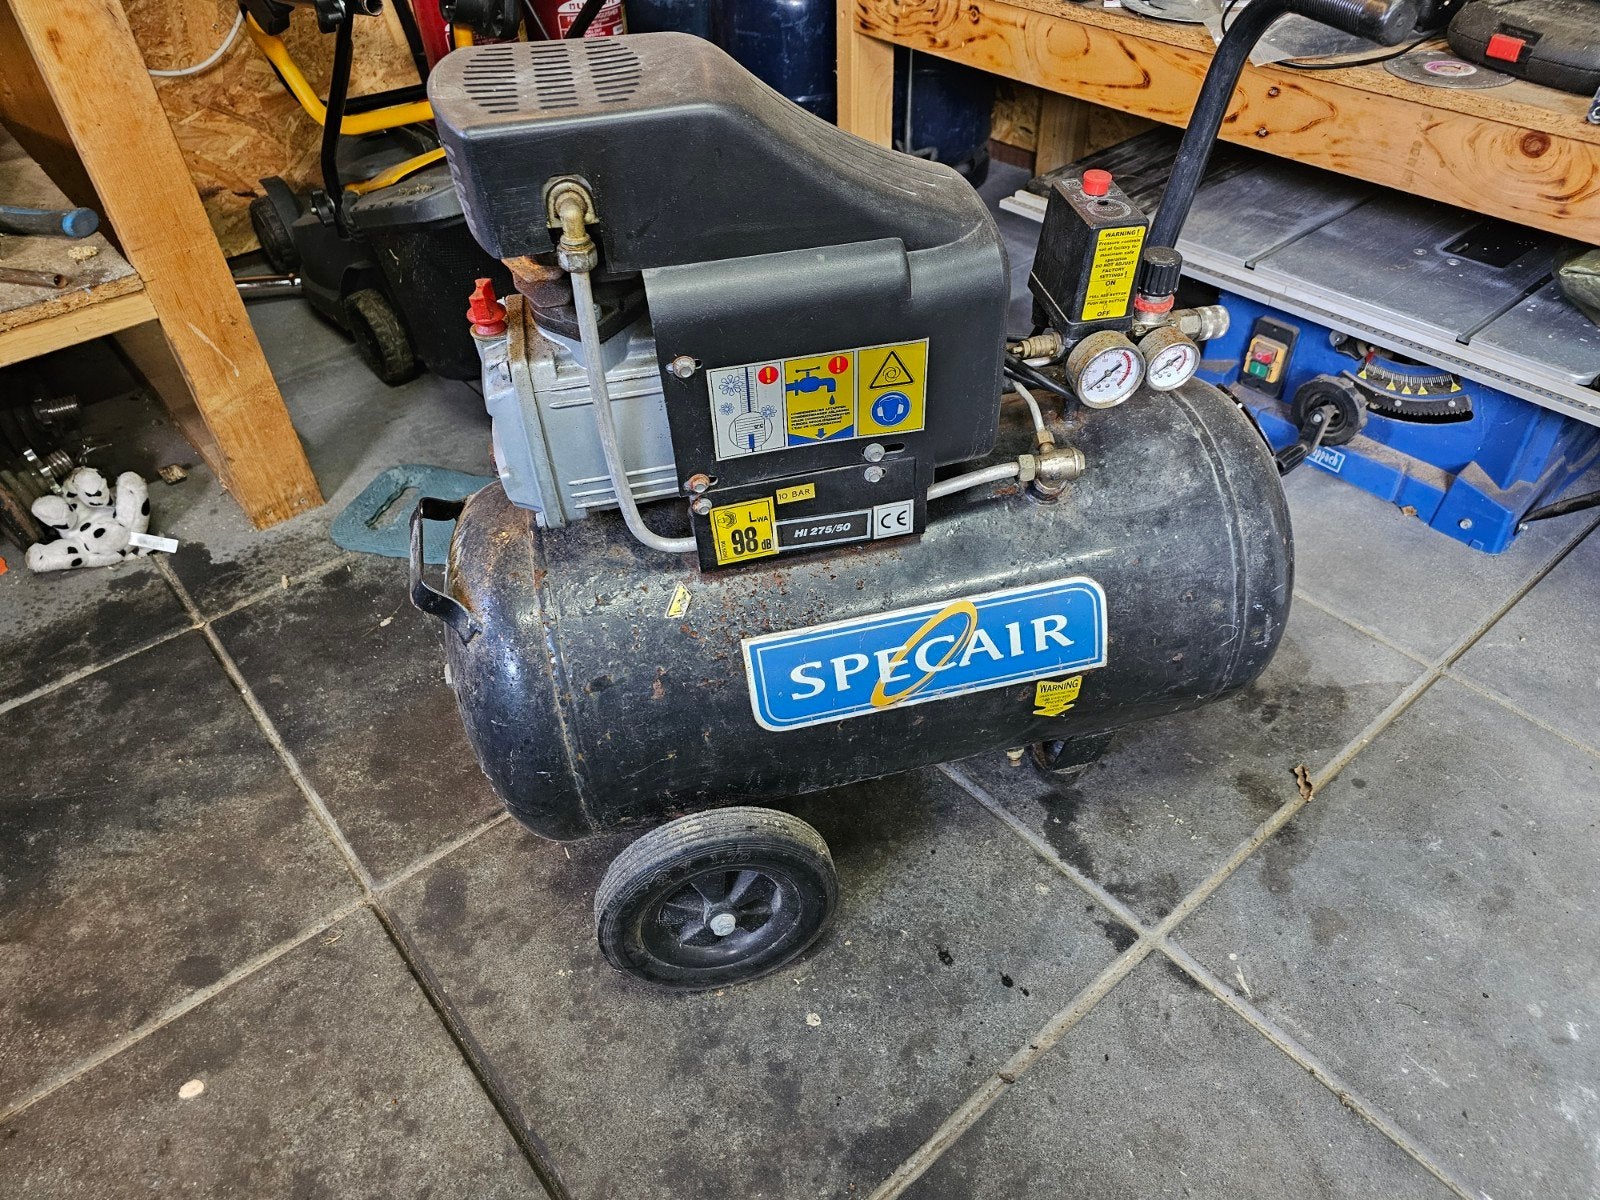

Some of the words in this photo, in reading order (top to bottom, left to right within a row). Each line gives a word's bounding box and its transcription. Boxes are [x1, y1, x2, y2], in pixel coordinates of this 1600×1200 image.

[791, 488, 811, 498] BAR
[794, 527, 808, 538] HI
[809, 522, 852, 536] 275/50
[731, 526, 758, 555] 98
[761, 538, 772, 550] dB
[790, 613, 1075, 701] SPECAIR
[1040, 679, 1079, 693] WARNING
